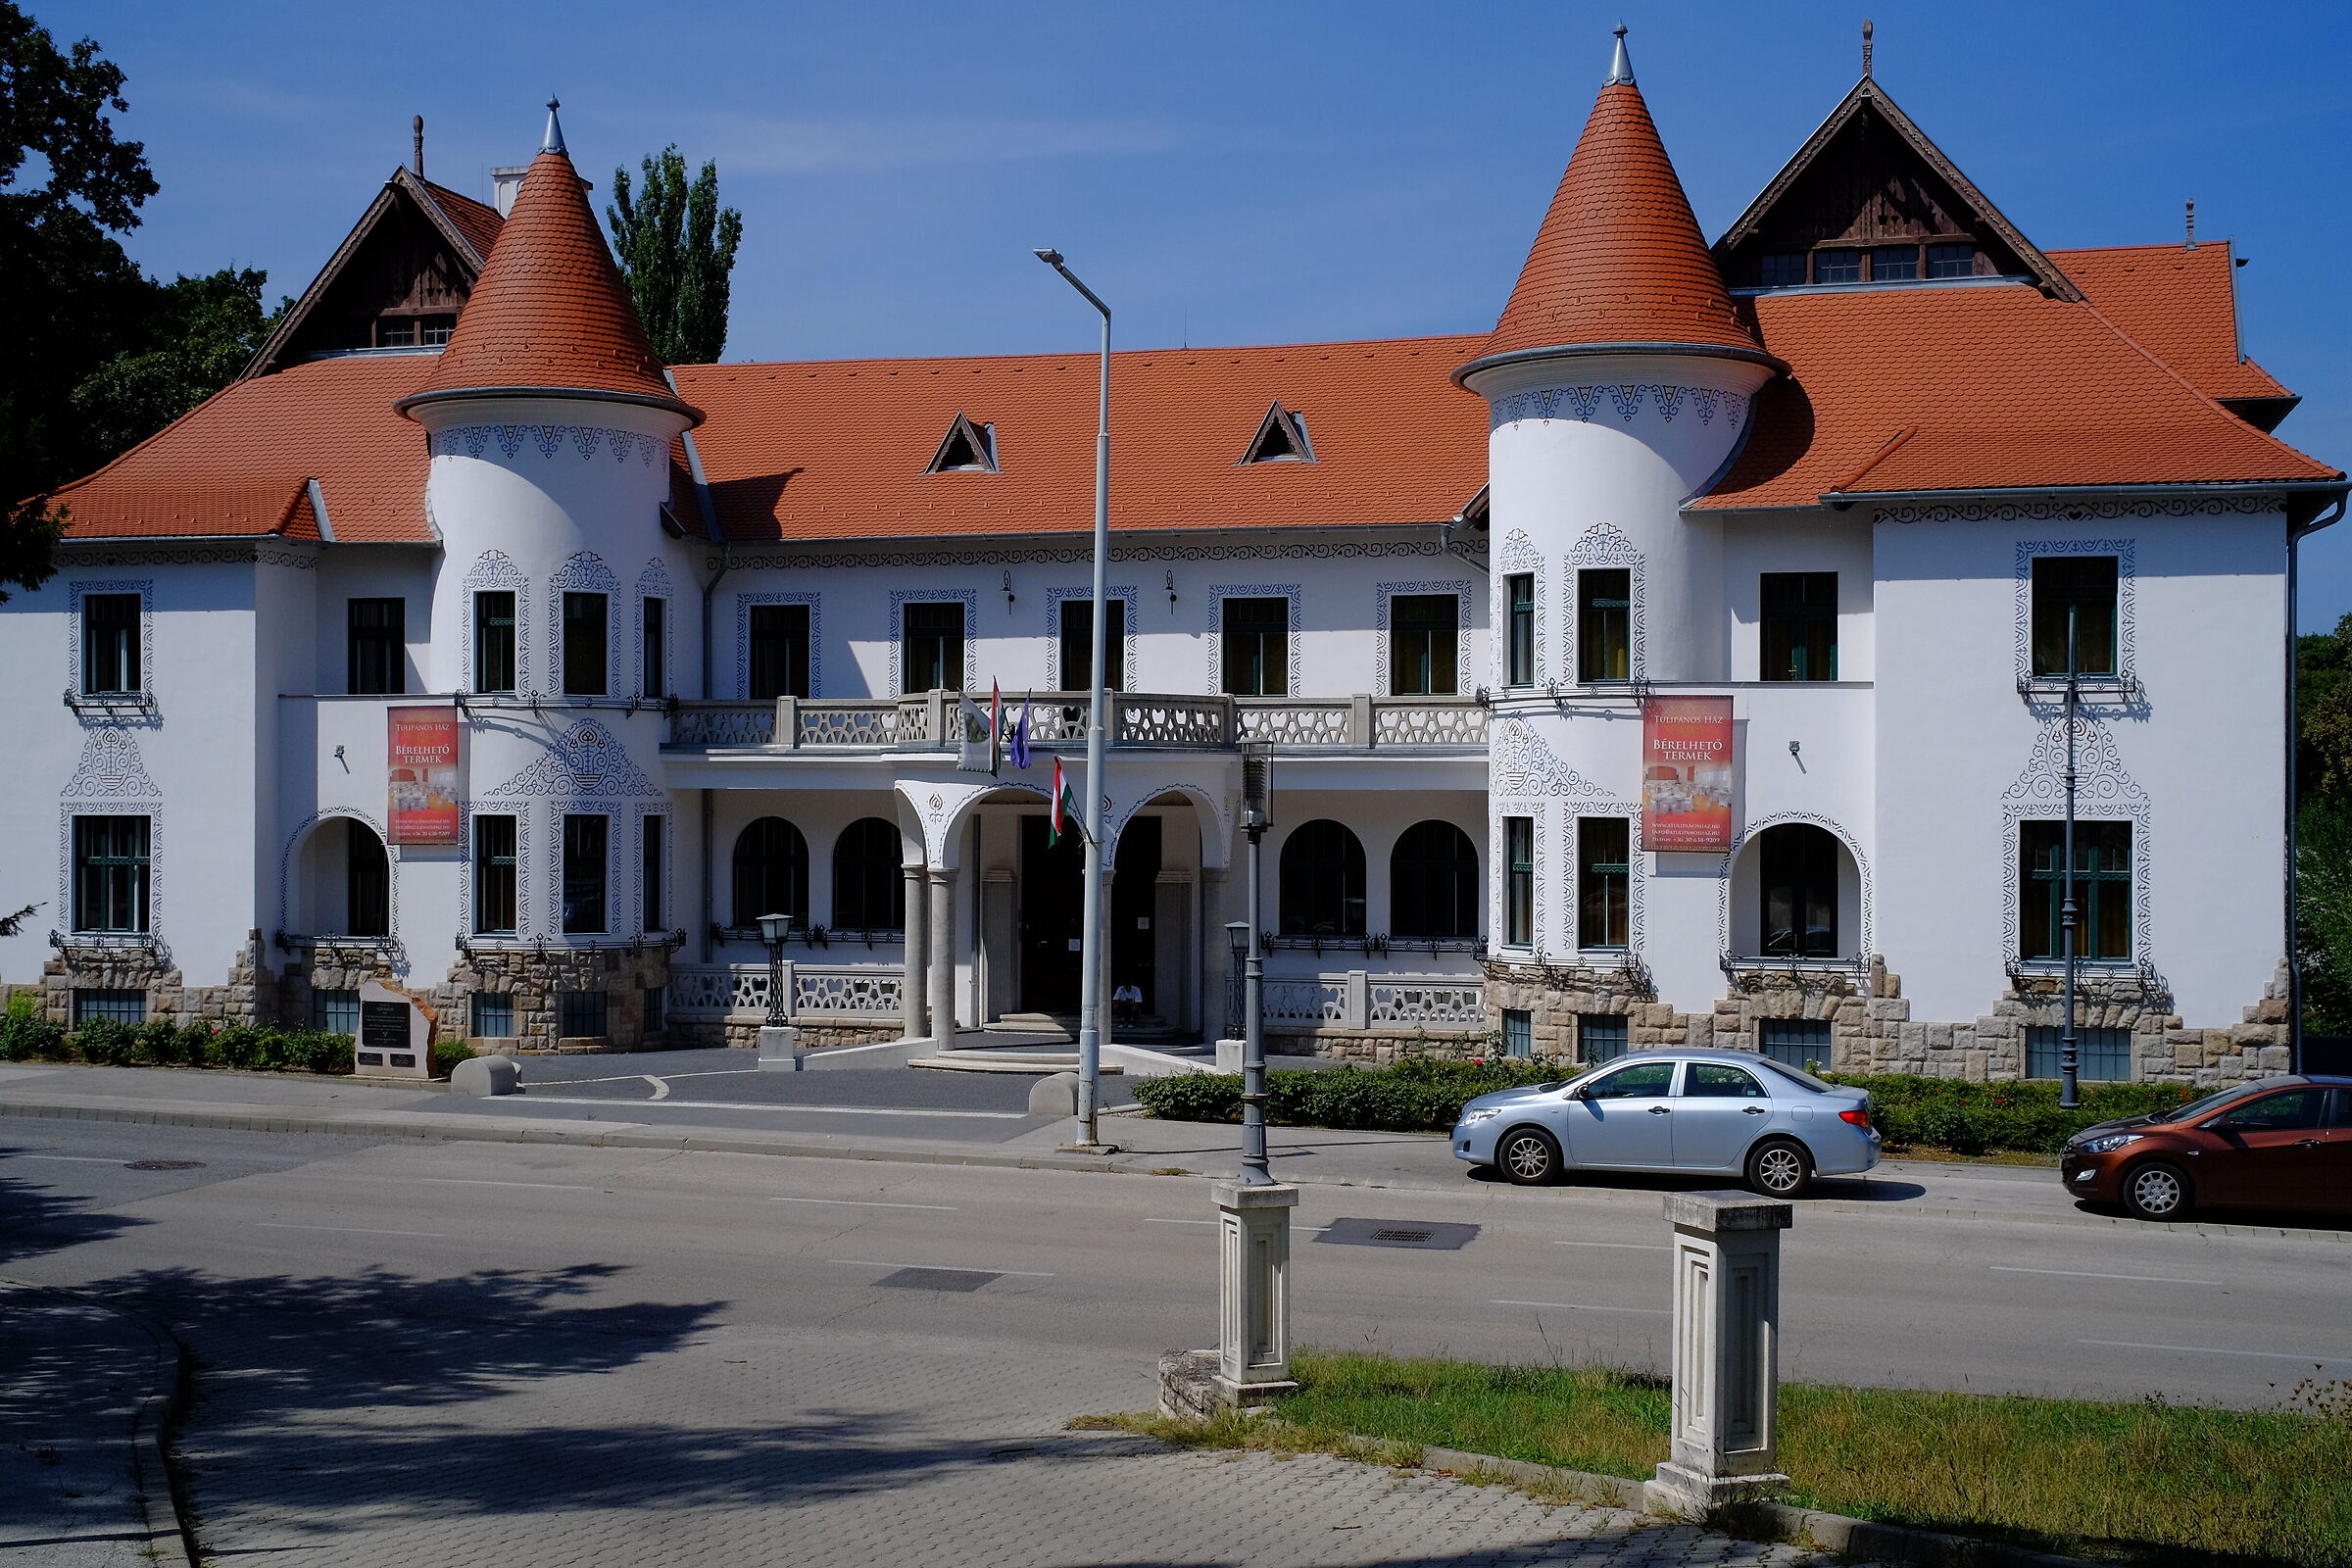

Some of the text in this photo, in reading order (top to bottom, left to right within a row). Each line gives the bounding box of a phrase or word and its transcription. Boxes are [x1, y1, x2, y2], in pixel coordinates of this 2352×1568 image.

[1704, 714, 1723, 724] HÁZ
[1653, 738, 1723, 751] BÉRELHETŐ
[403, 755, 443, 763] TERMEK
[1663, 751, 1712, 760] TERMEK
